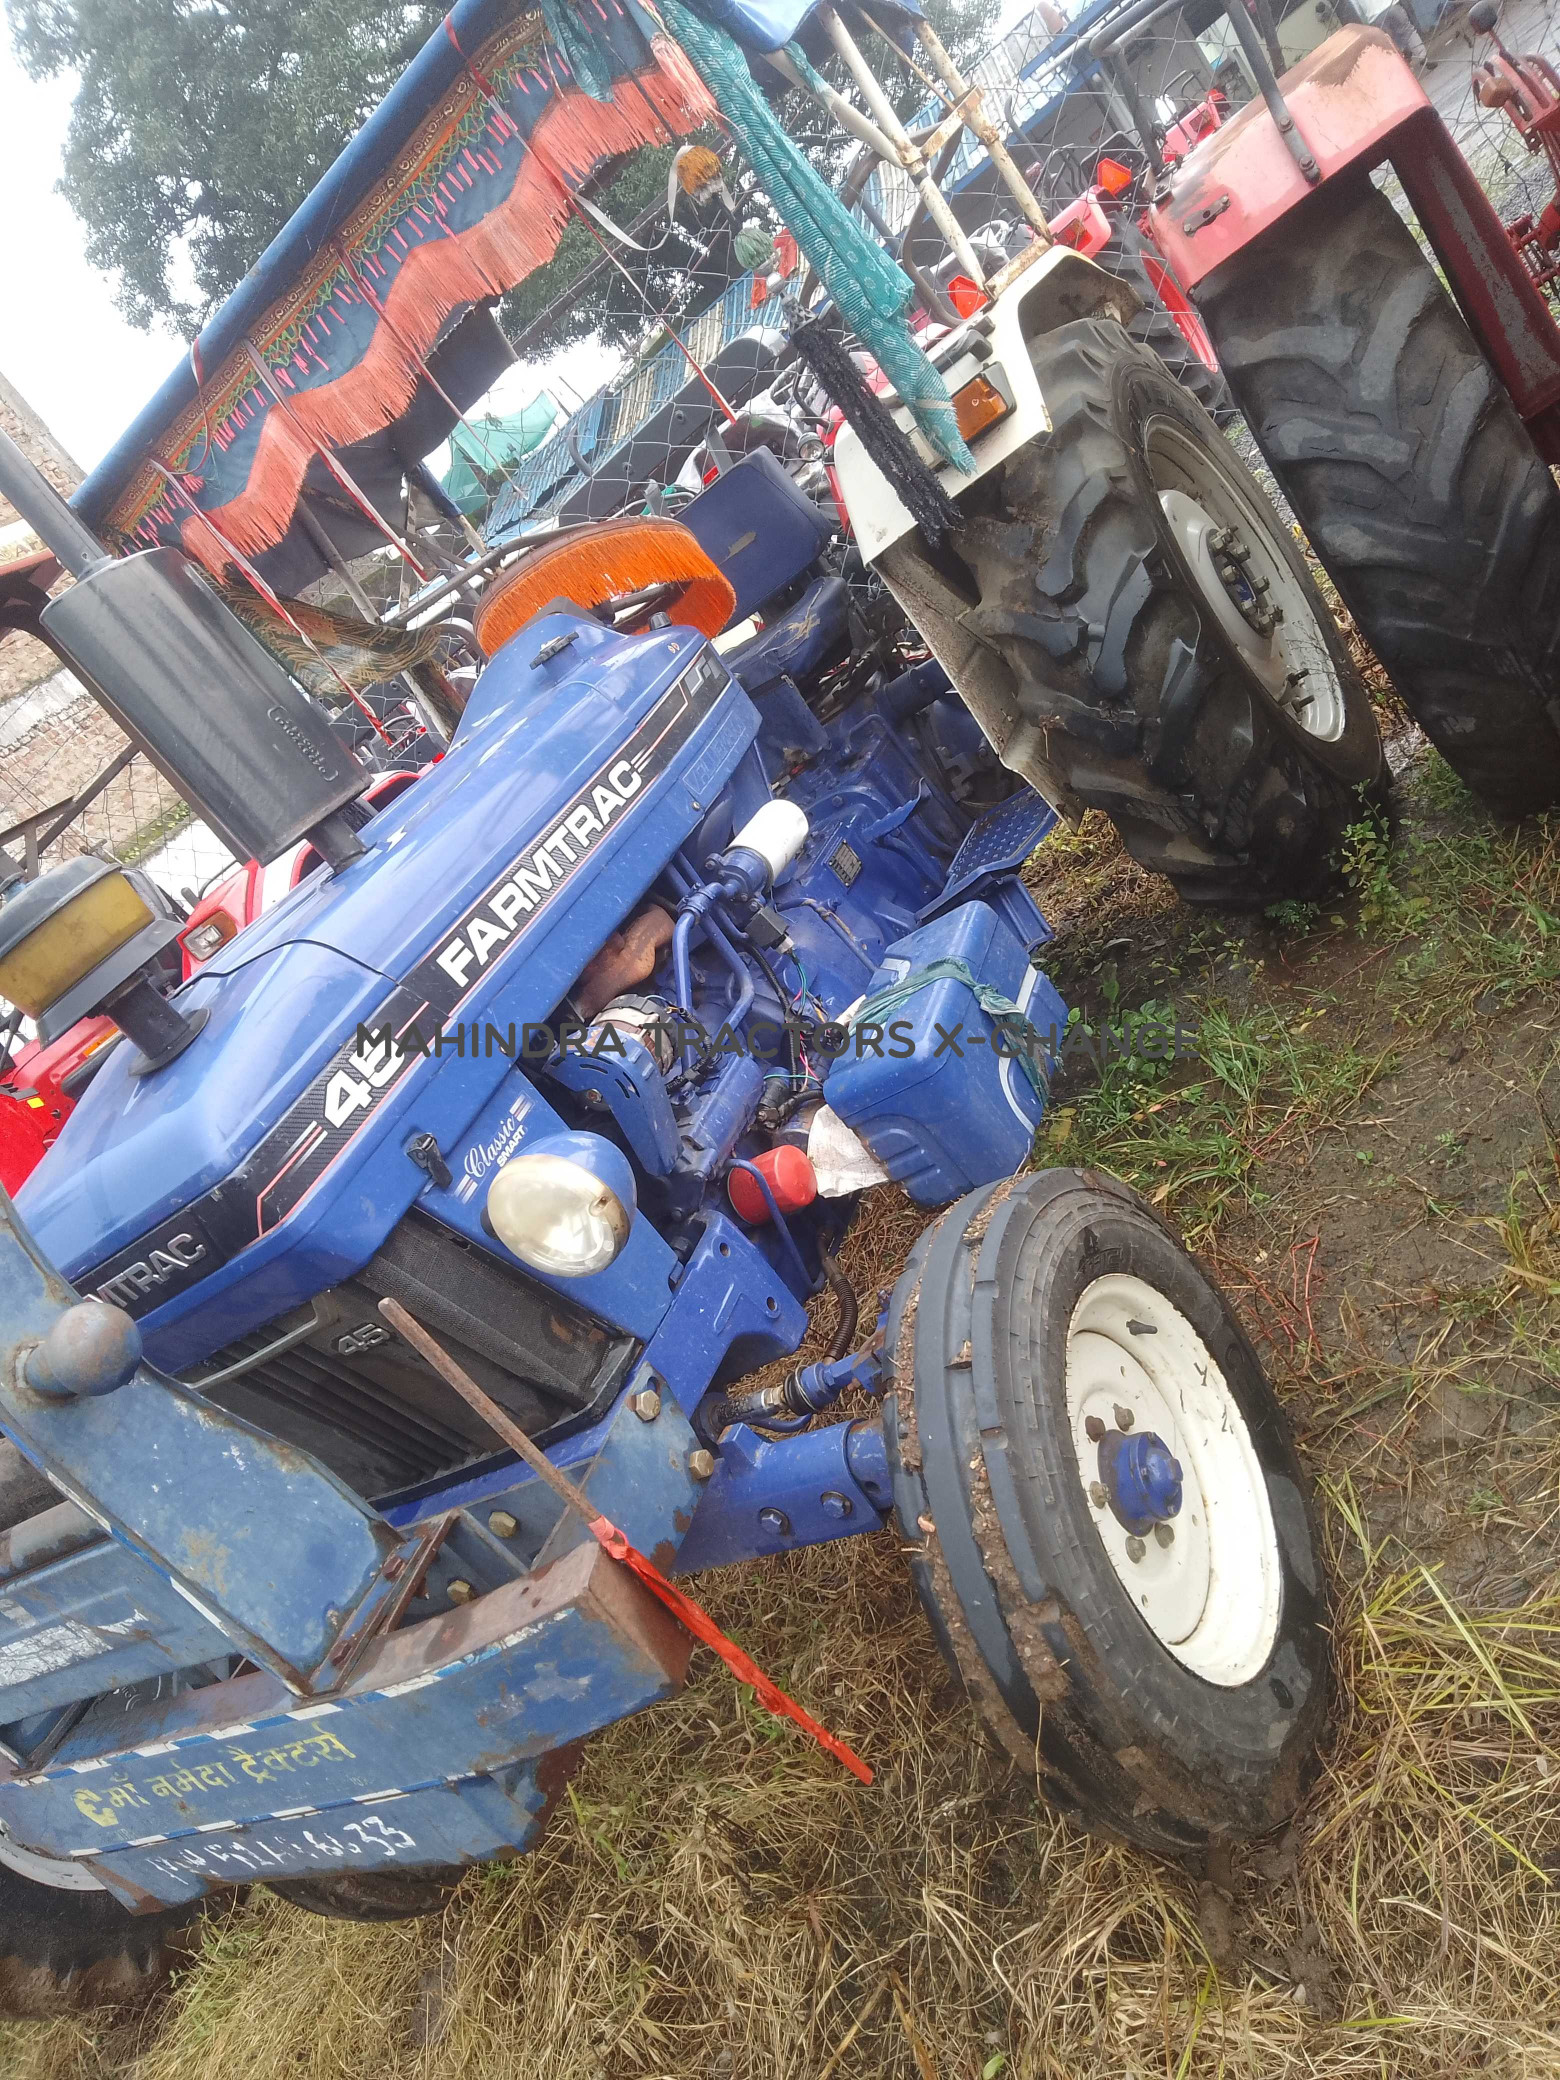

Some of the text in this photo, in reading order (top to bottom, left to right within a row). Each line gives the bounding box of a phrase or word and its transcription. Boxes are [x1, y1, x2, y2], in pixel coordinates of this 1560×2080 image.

[435, 759, 643, 989] FARMTRAC
[323, 1027, 406, 1129] 45
[463, 1115, 516, 1178] Classic
[496, 1124, 526, 1169] SMART
[338, 1322, 391, 1356] 45
